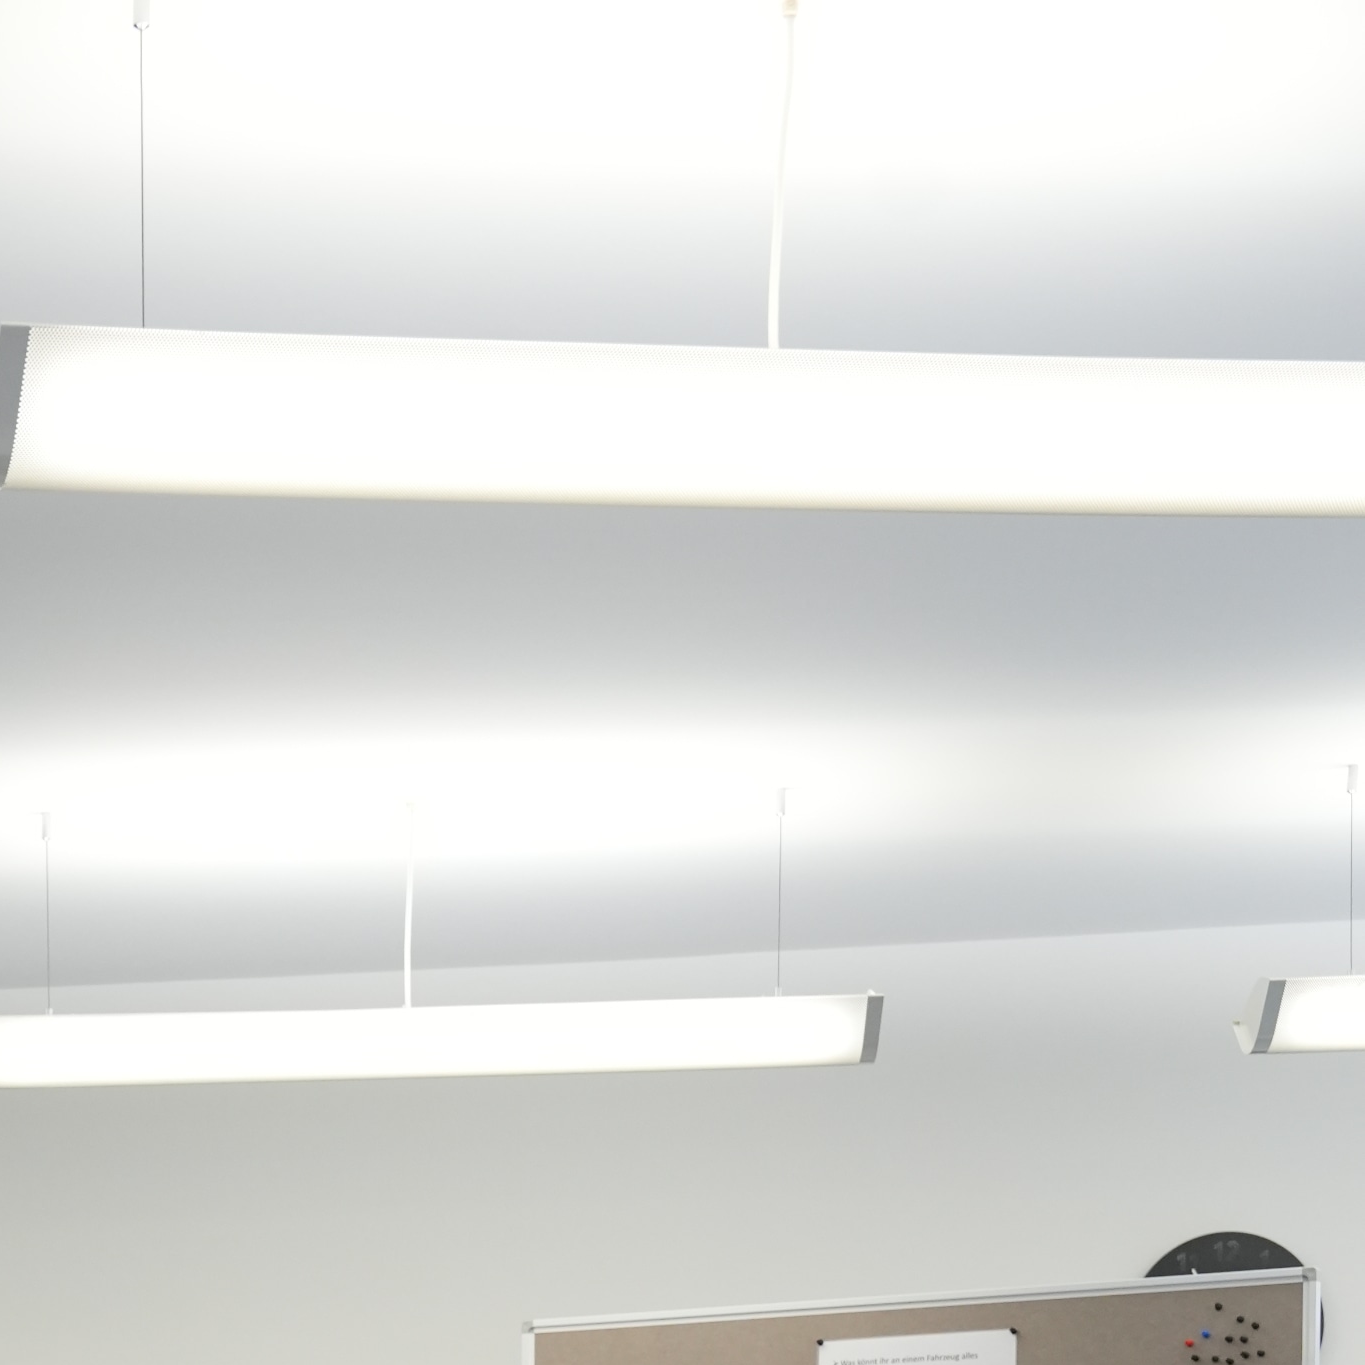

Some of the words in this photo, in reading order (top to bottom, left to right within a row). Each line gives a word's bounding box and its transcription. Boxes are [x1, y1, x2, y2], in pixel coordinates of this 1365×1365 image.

[857, 1357, 877, 1365] könnt
[880, 1356, 889, 1365] ihr
[902, 1355, 924, 1363] einem
[927, 1353, 960, 1362] Fahrzeug
[962, 1352, 978, 1360] alles
